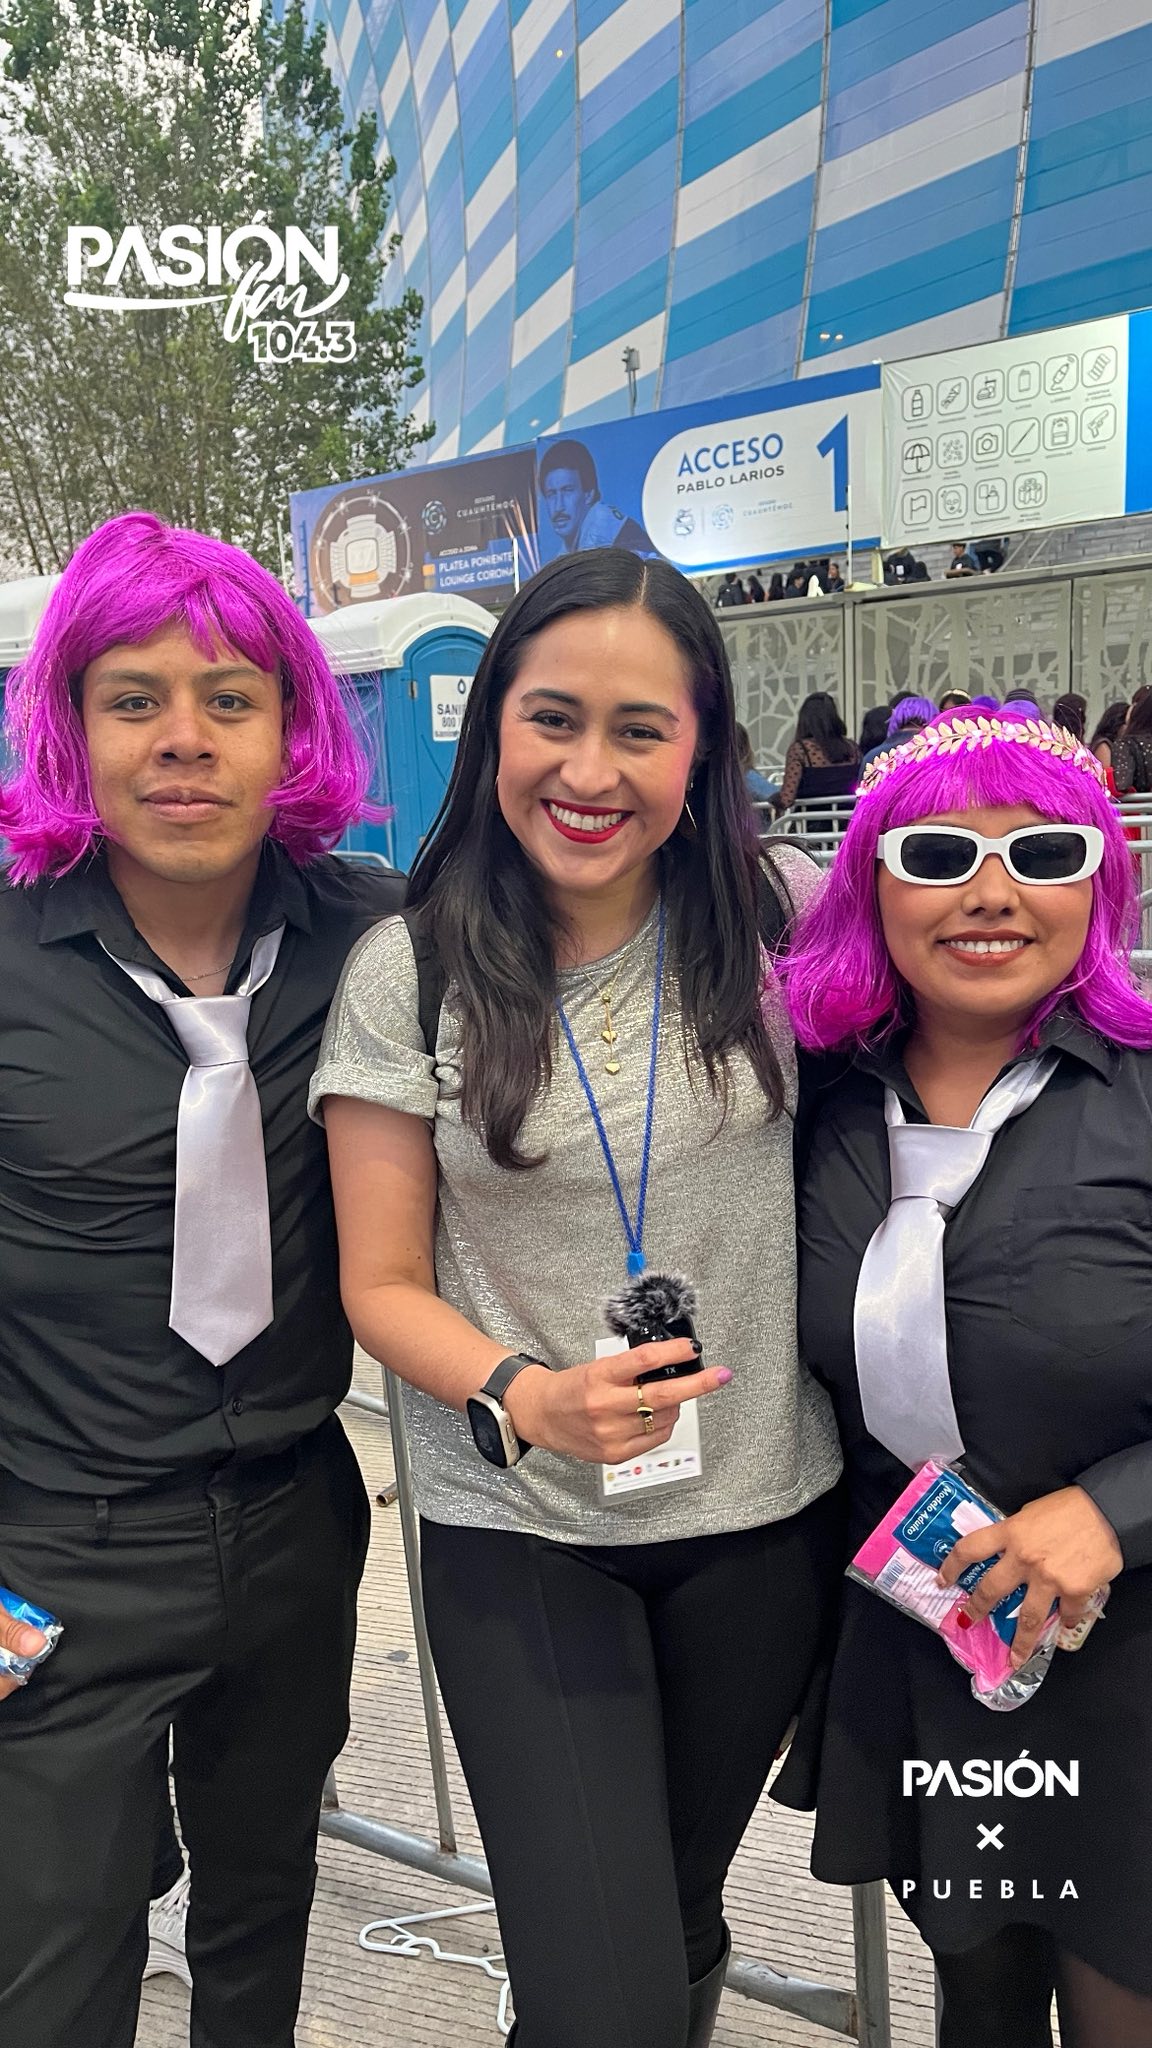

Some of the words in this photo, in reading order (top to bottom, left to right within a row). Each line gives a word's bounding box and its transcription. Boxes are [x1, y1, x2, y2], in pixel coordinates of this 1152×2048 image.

[677, 433, 784, 477] ACCESO
[816, 414, 848, 513] 1
[676, 476, 725, 495] PABLO
[730, 465, 785, 485] LARIOS
[439, 560, 470, 573] PLATEA
[471, 551, 514, 567] PONIENTE
[440, 573, 476, 587] LOUNGE
[664, 1366, 676, 1375] TX
[926, 1485, 952, 1512] Modelo
[907, 1509, 929, 1535] Adulto
